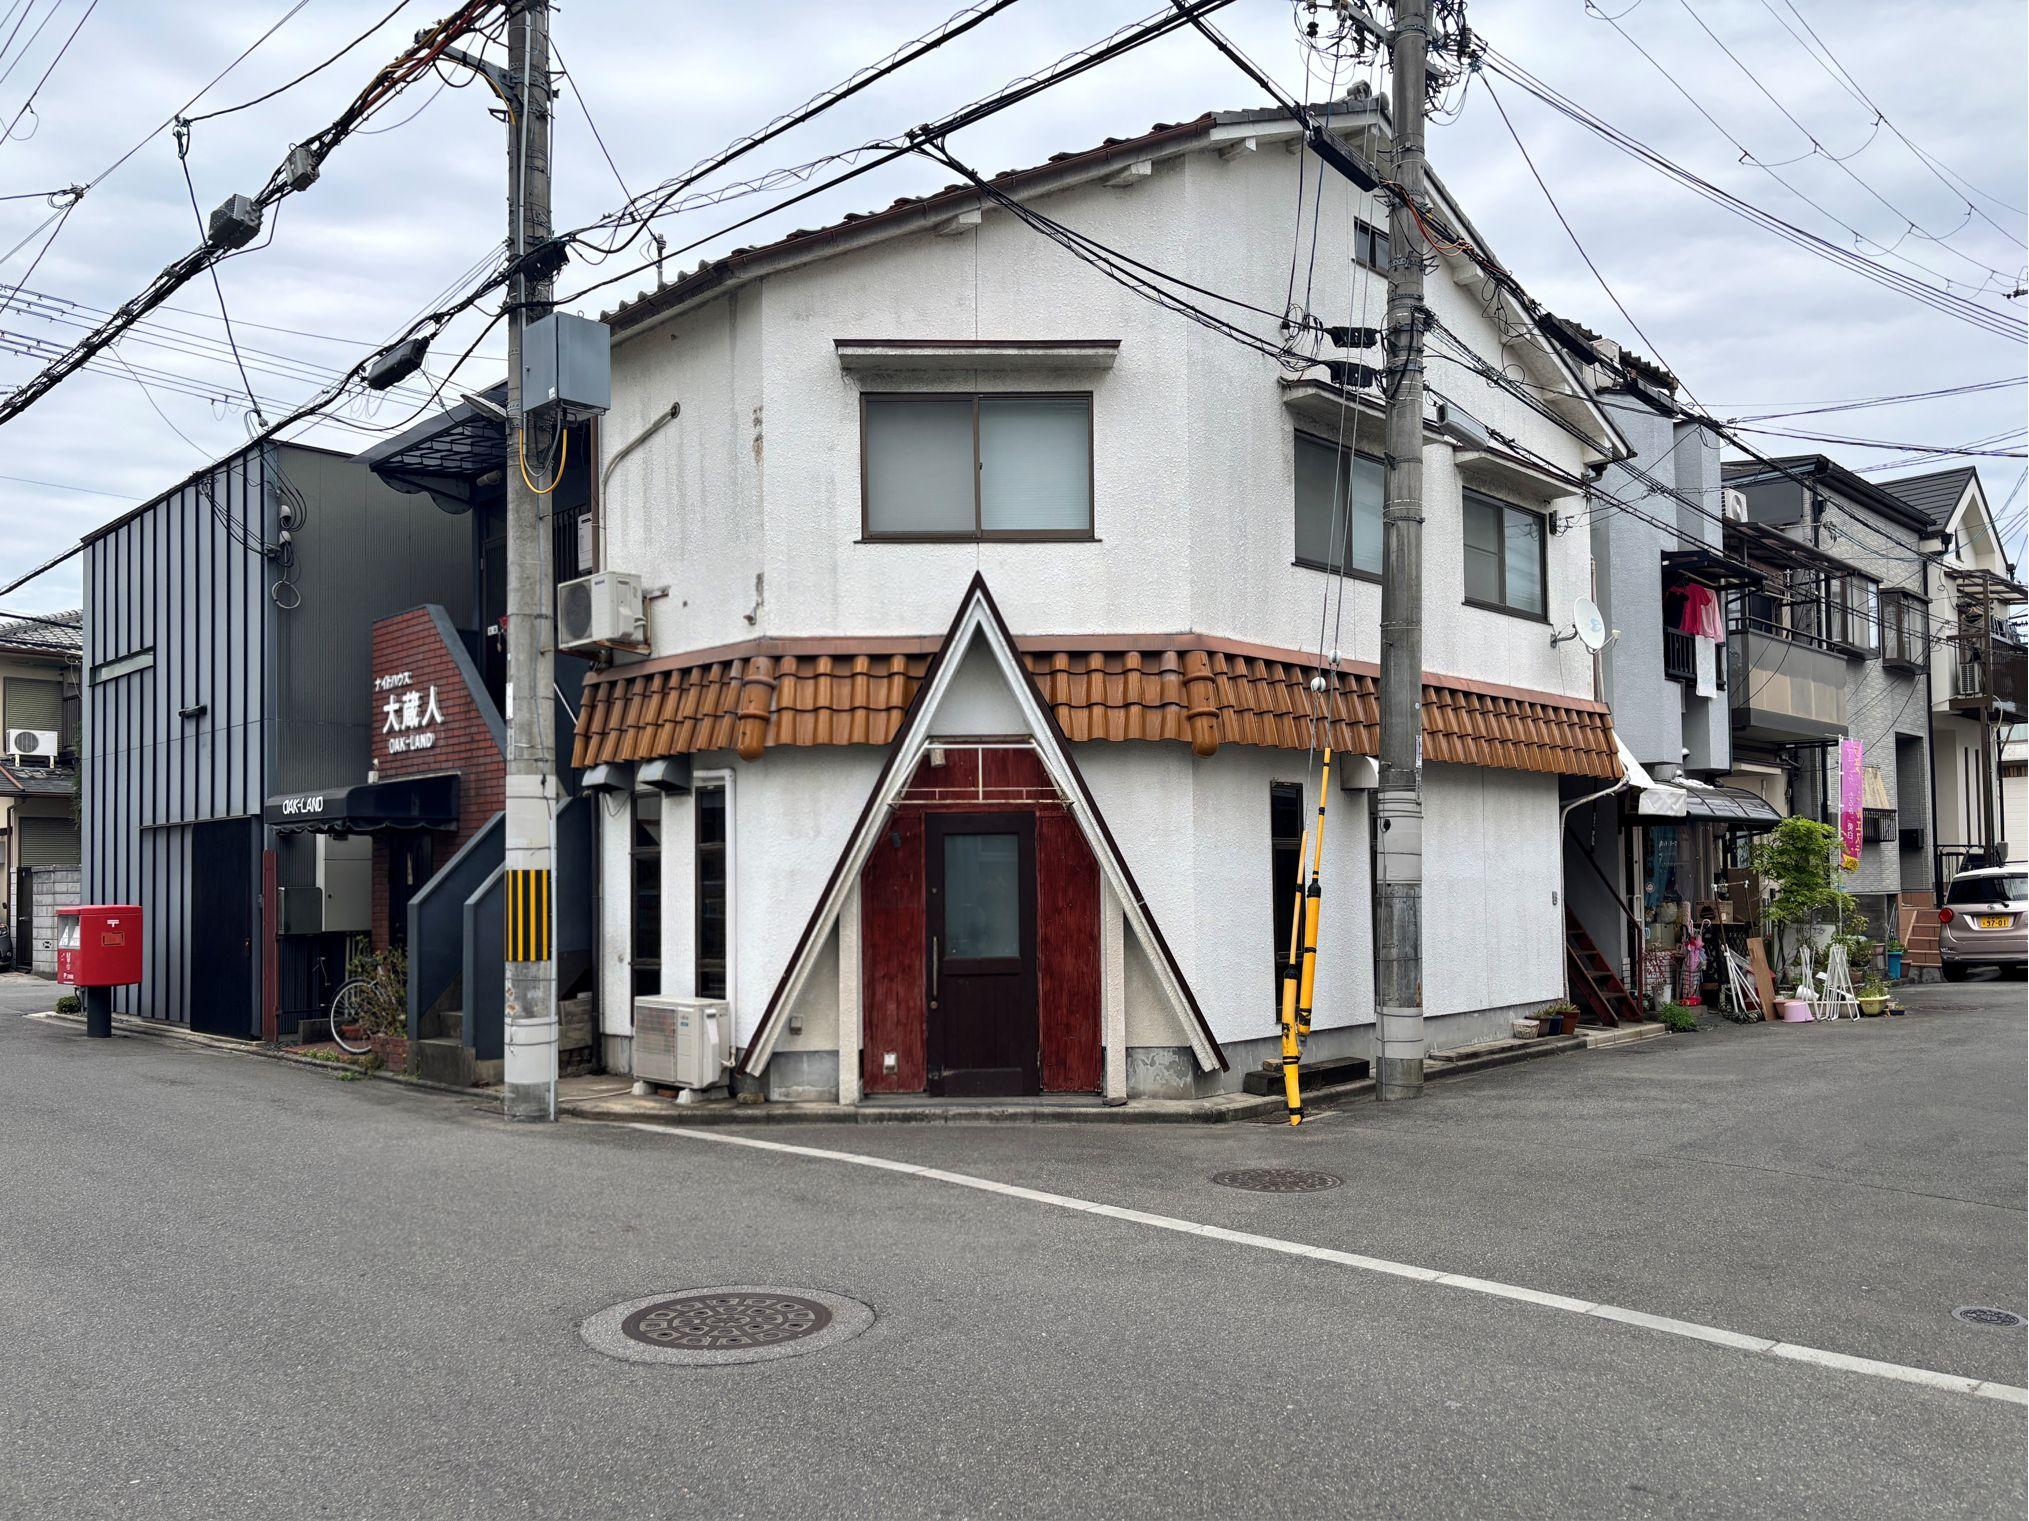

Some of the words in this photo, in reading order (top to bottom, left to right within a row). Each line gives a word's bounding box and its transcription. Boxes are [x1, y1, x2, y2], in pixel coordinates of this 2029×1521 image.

[375, 672, 412, 691] ナイトハウス
[382, 685, 443, 733] 大蔵人
[389, 733, 434, 753] OAK-LAND
[282, 796, 323, 815] OAK-LAND
